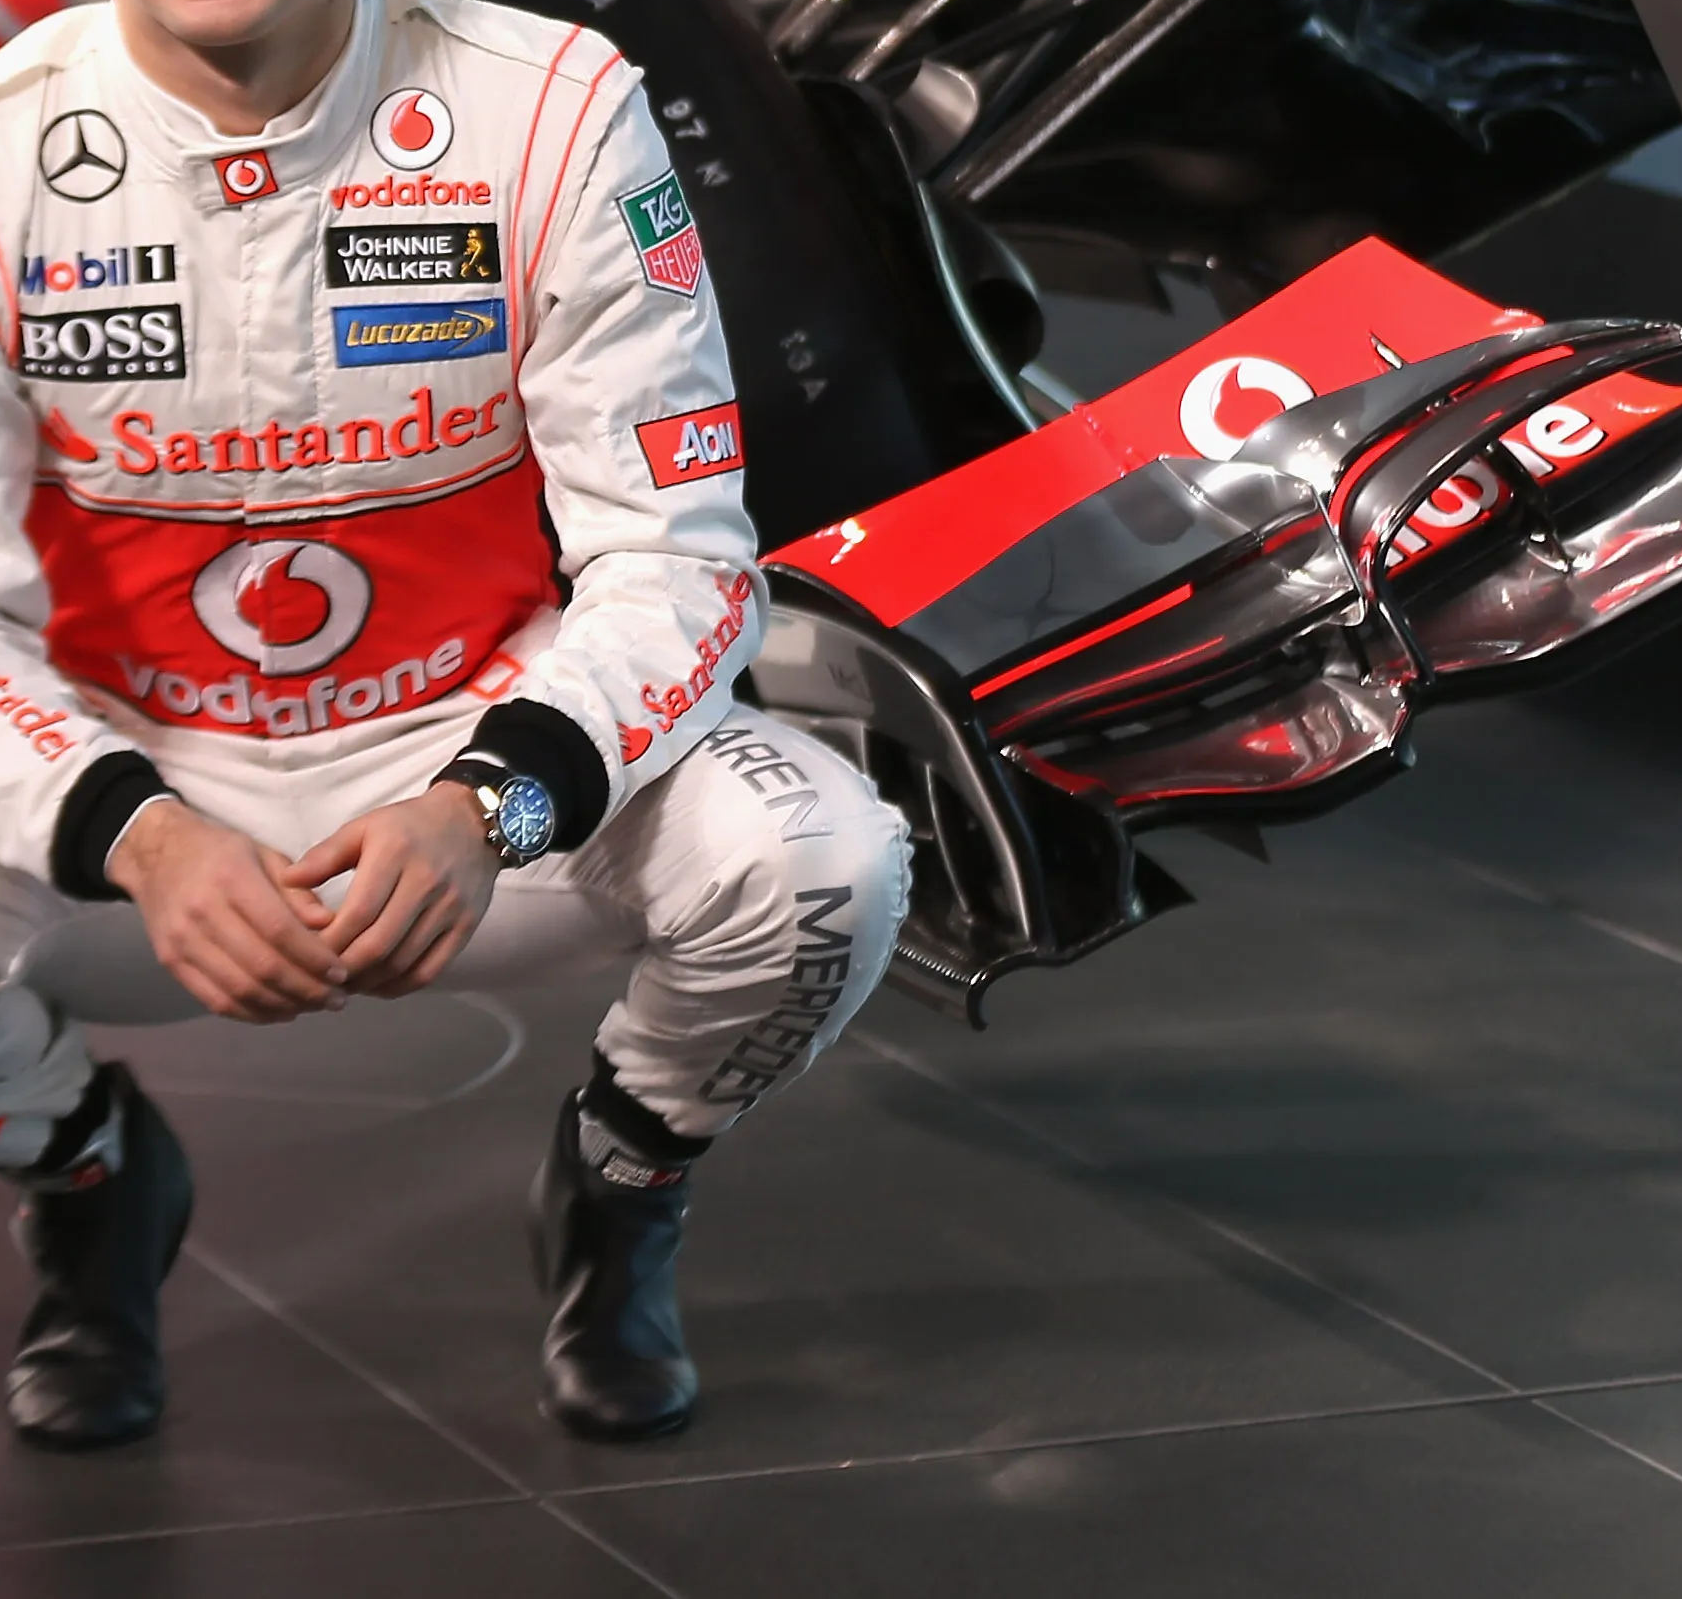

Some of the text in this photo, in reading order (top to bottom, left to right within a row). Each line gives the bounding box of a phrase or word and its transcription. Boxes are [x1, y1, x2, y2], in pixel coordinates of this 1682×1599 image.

[332, 175, 492, 210] vodafone
[640, 186, 684, 238] TAG
[337, 235, 453, 257] JOHNNIE
[343, 259, 453, 282] WALKER
[650, 231, 700, 285] HEUER
[20, 248, 128, 295] Mobil
[20, 312, 178, 362] BOSS
[346, 317, 474, 347] Lucozade
[110, 385, 508, 476] Santander
[123, 638, 464, 737] vodafone
[703, 726, 834, 844] AREN
